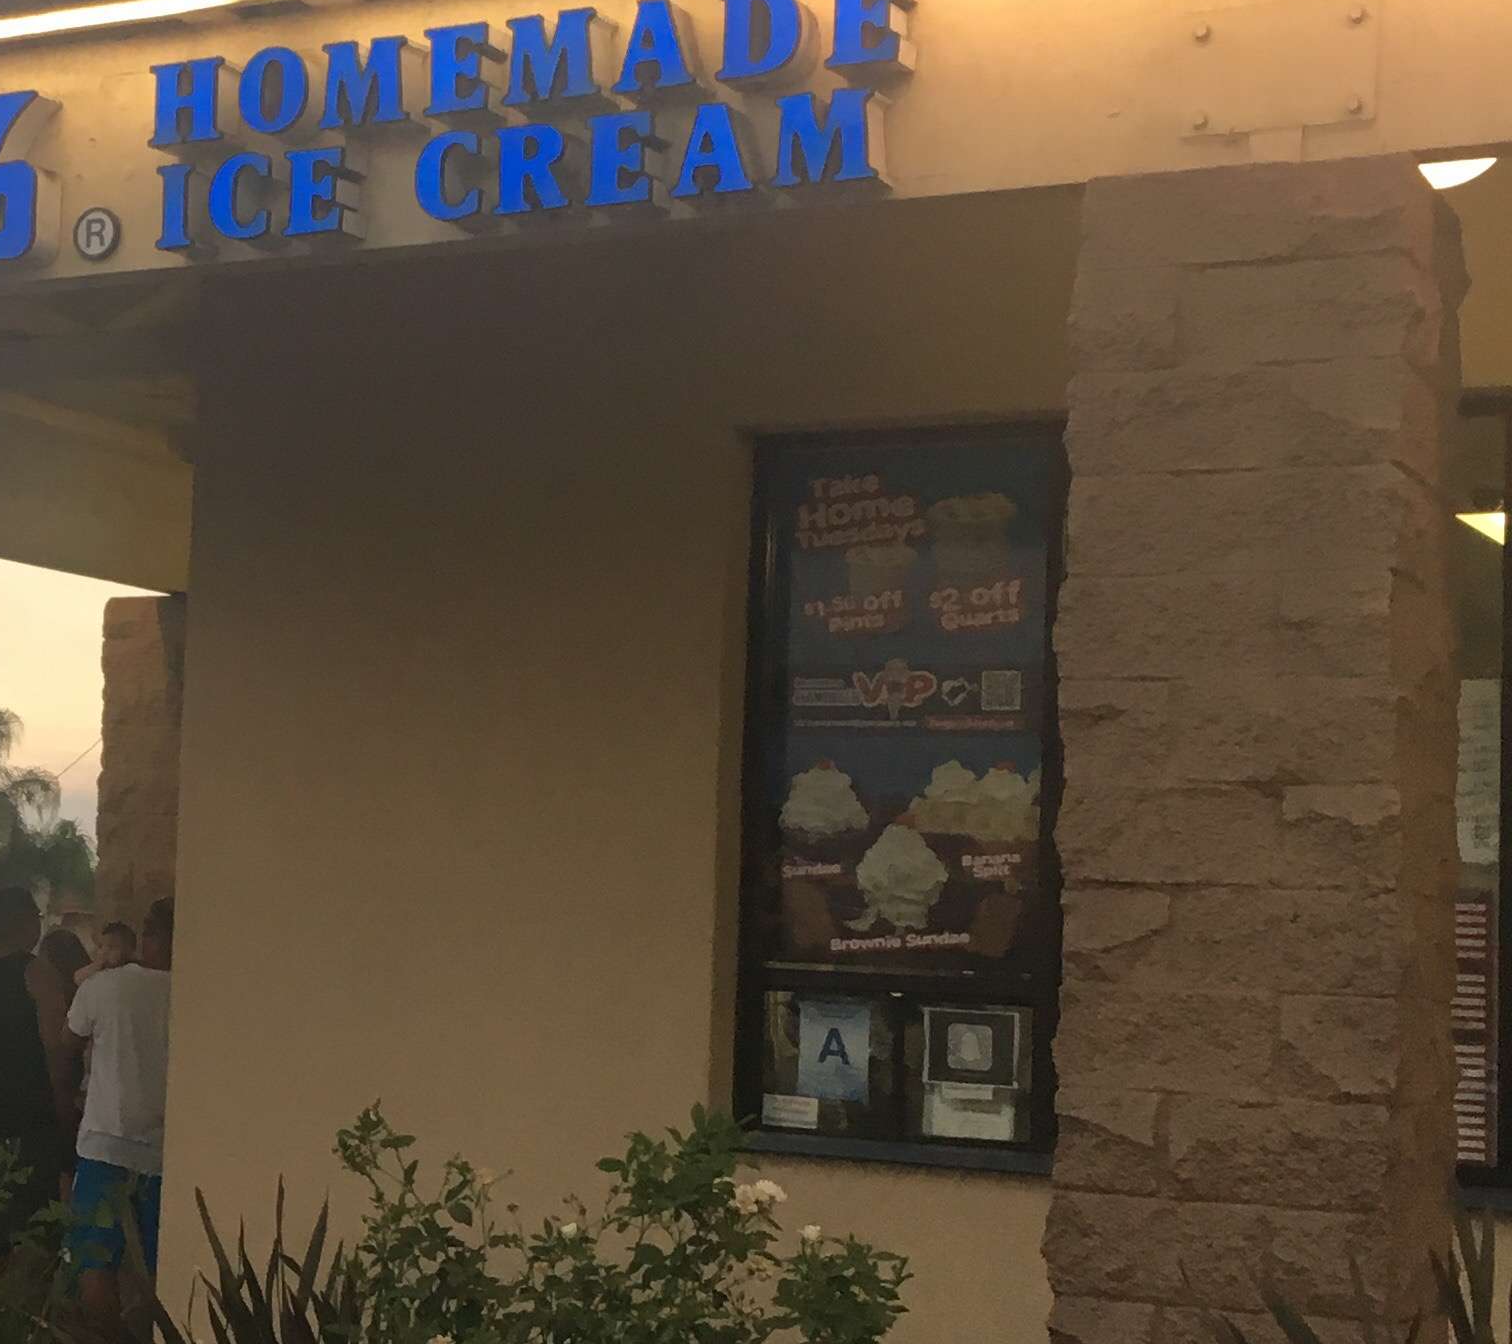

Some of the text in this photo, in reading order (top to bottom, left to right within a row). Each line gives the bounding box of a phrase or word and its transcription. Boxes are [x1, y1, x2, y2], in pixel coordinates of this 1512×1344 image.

[155, 88, 884, 252] ICE CREAM
[782, 863, 841, 878] Sundae
[830, 932, 969, 952] Brownie Sundae
[817, 1027, 850, 1066] A
